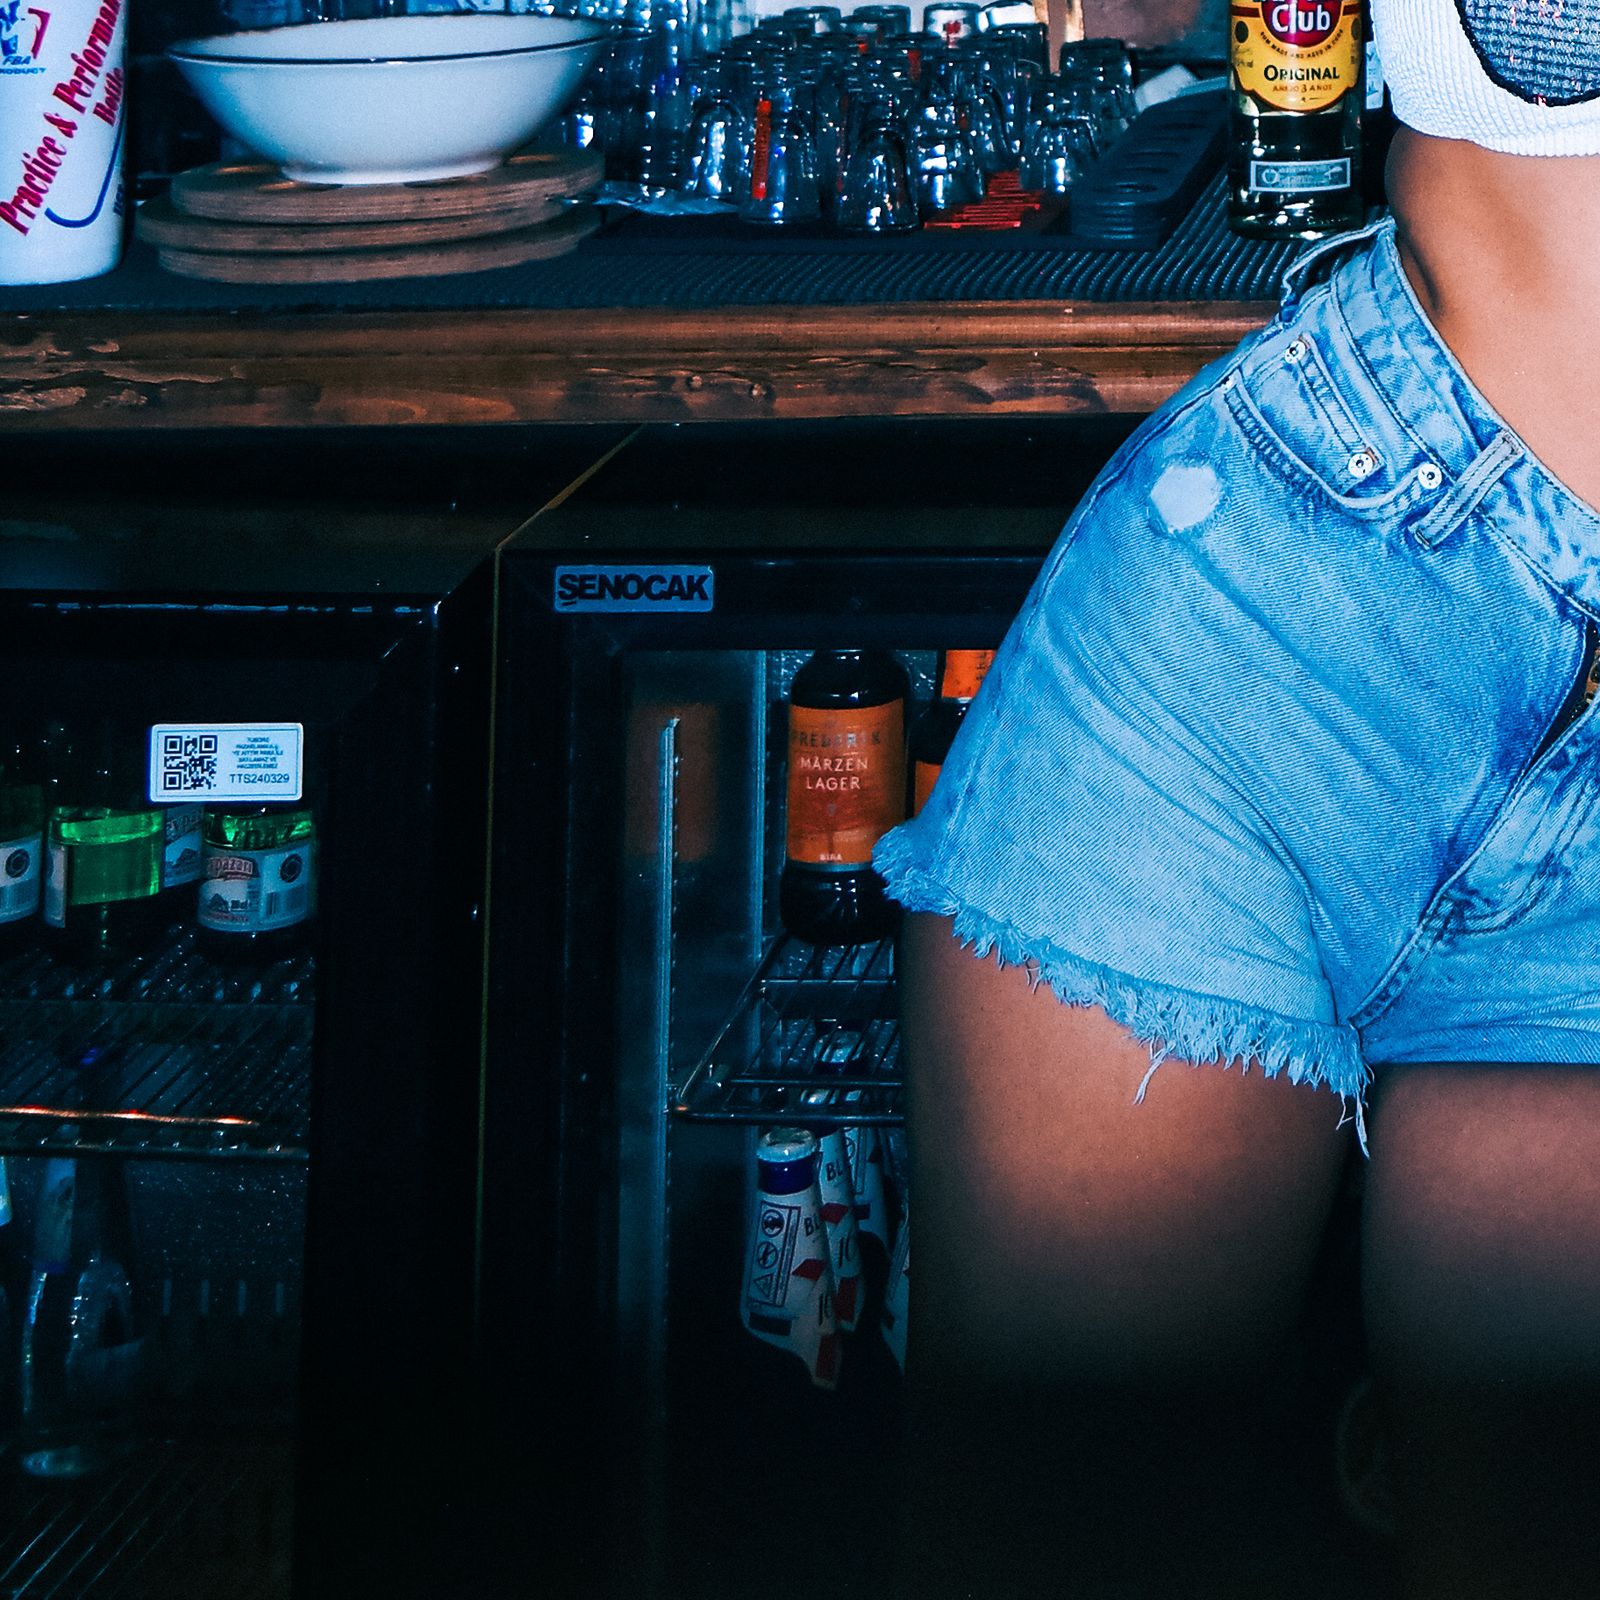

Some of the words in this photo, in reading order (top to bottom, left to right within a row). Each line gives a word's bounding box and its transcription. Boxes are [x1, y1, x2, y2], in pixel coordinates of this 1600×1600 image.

[1271, 1, 1332, 35] Club
[3, 54, 32, 66] FBA
[0, 67, 47, 76] RODUCT
[93, 66, 126, 128] Bottle
[0, 135, 68, 237] Practice
[43, 111, 79, 139] &
[229, 773, 290, 784] TTS240329
[806, 776, 861, 791] LAGER
